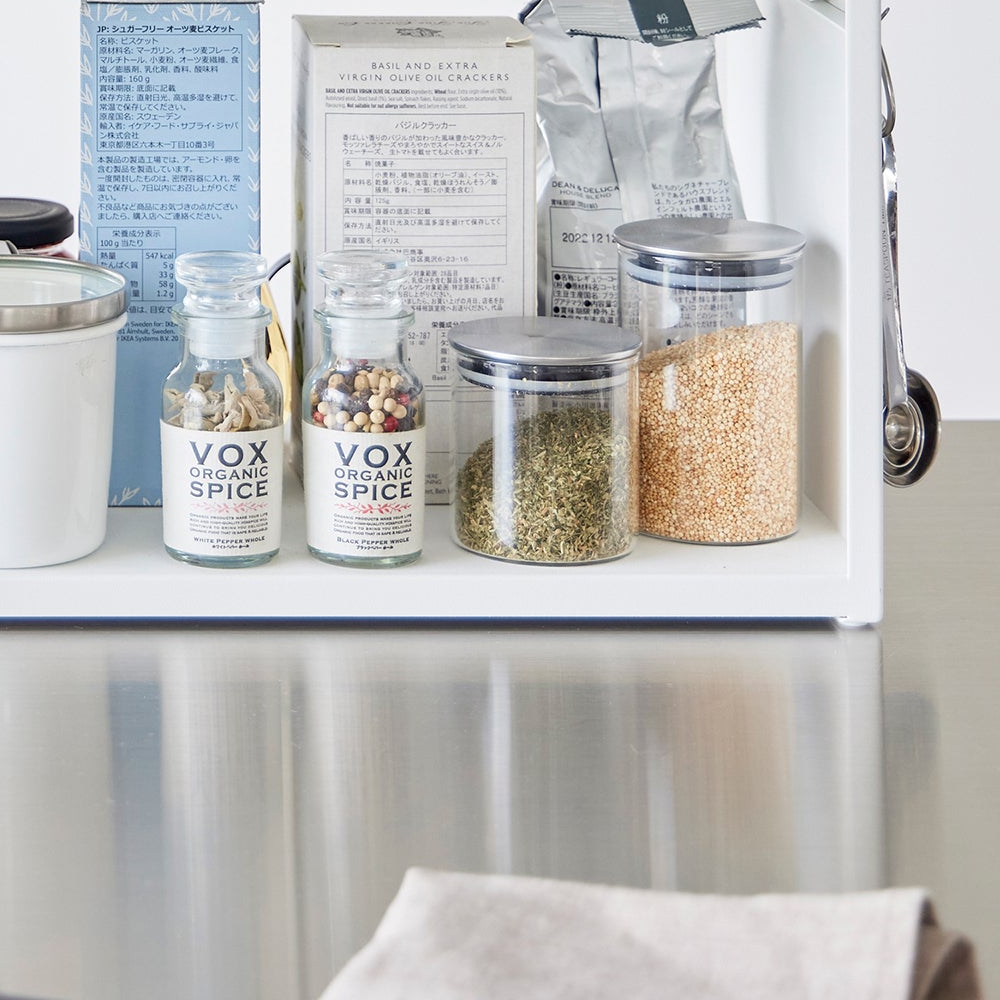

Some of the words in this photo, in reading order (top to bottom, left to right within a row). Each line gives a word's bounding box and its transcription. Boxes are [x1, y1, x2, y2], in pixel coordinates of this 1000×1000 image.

[448, 73, 510, 82] CRACKERS
[395, 122, 457, 130] バジルクラッカー
[552, 181, 575, 189] DEAN
[591, 233, 603, 243] 12
[189, 440, 268, 467] VOX
[334, 442, 412, 468] VOX
[190, 466, 268, 480] ORGANIC
[334, 468, 412, 481] ORGANIC
[190, 480, 268, 499] SPICE
[334, 481, 412, 500] SPICE
